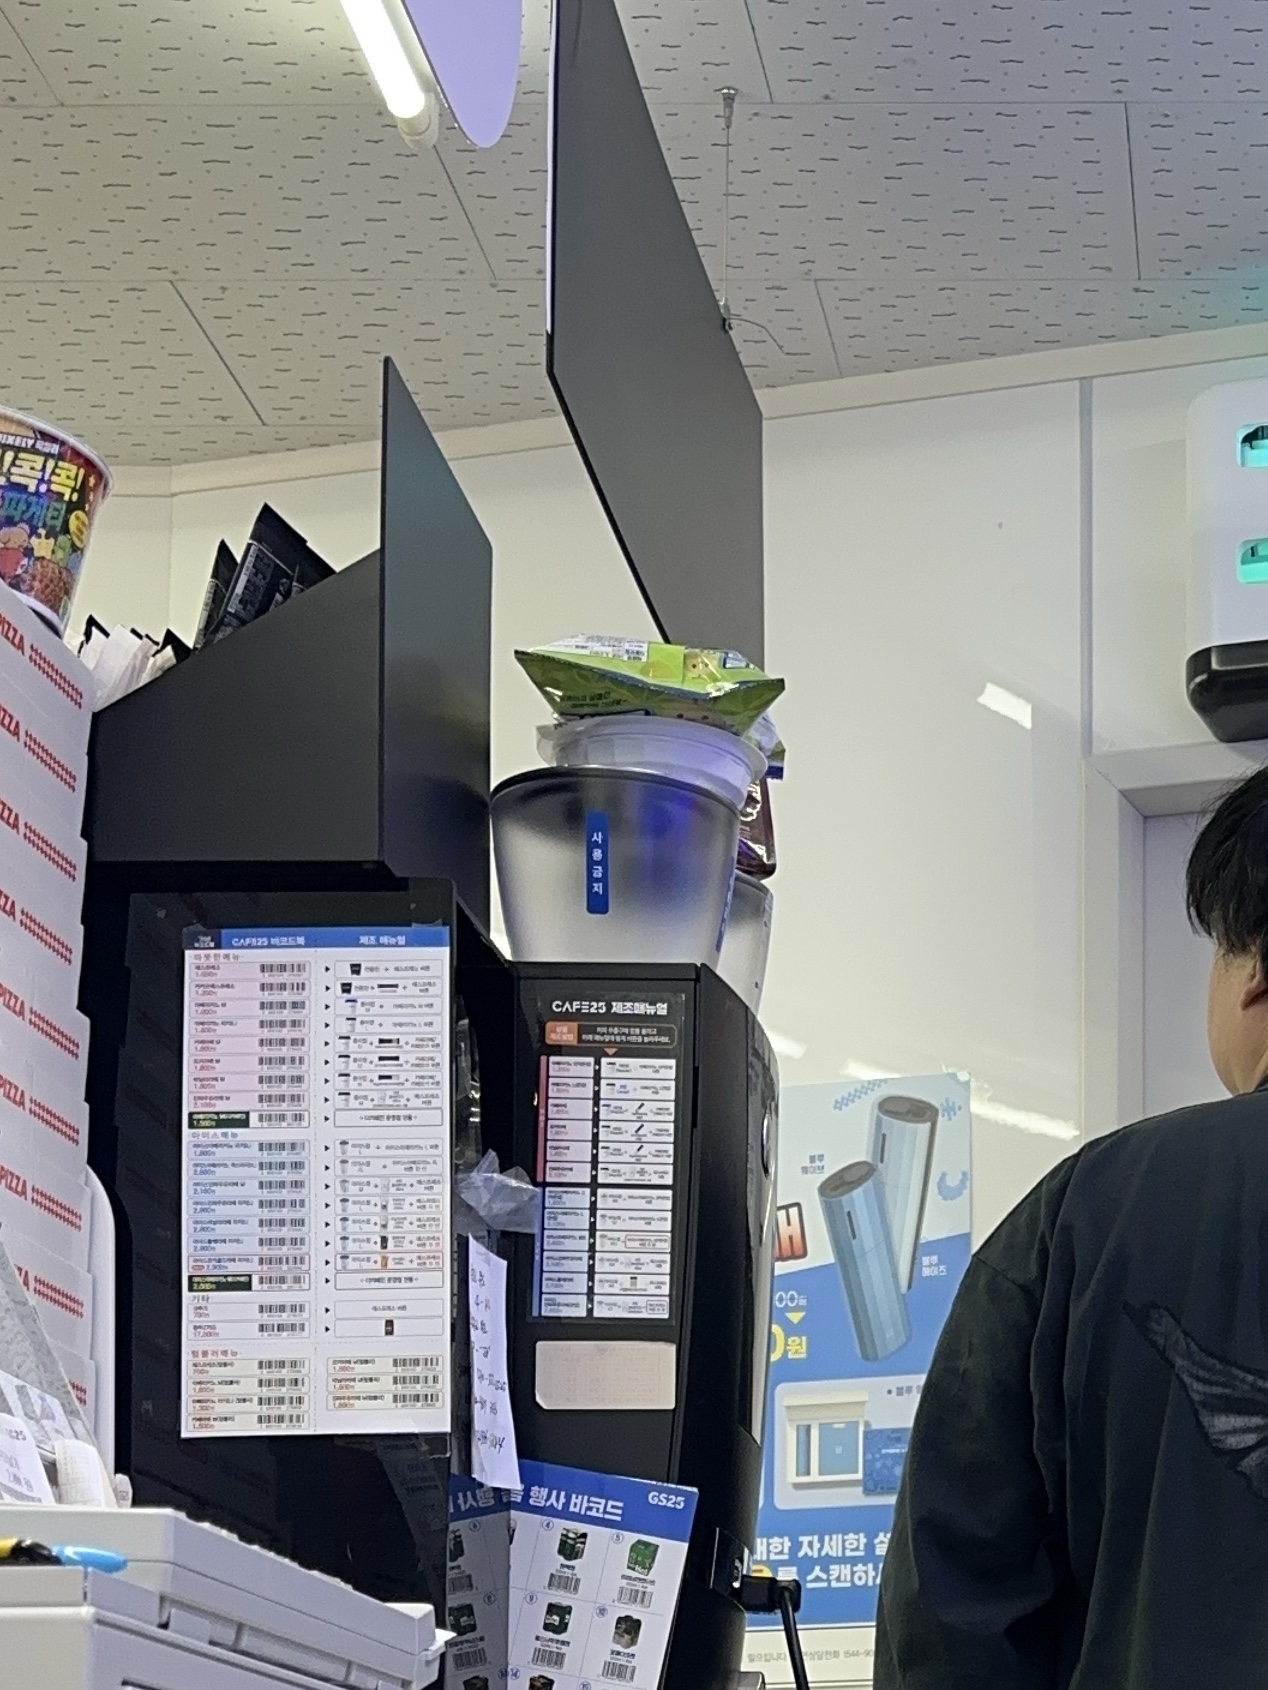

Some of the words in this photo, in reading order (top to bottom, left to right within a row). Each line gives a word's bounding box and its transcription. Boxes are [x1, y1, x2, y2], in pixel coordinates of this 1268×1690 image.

[591, 831, 603, 896] 사용금지
[529, 1485, 567, 1512] 행사
[570, 1496, 624, 1522] 바코드
[648, 1491, 685, 1509] GS25
[797, 1532, 867, 1559] 자세한
